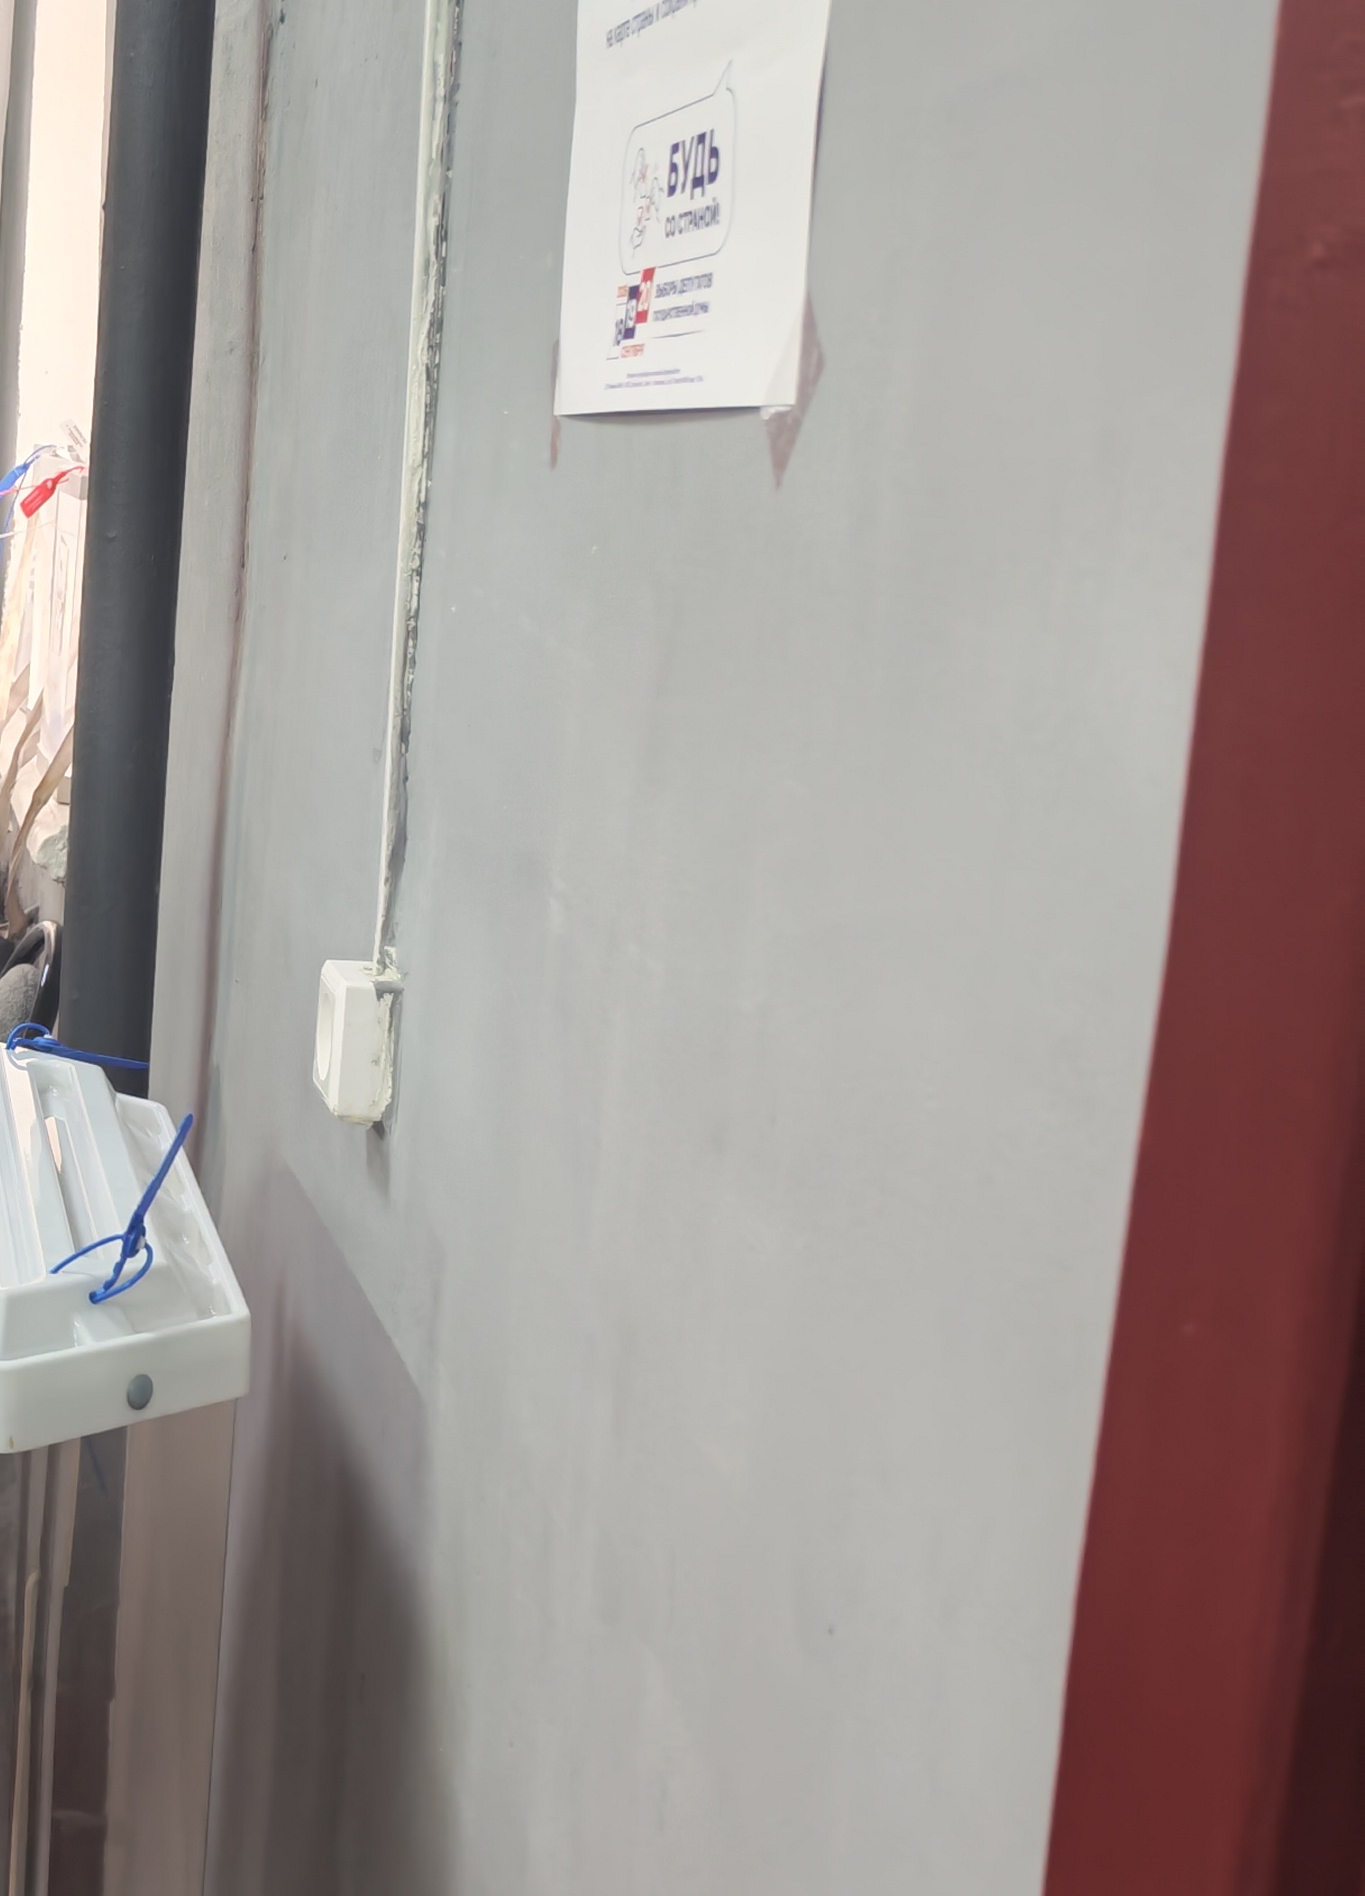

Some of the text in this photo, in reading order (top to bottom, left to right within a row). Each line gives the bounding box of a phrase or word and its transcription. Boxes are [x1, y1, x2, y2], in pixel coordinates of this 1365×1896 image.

[667, 128, 720, 201] БУДЬ
[664, 196, 721, 239] СО СТРАНОЙ!
